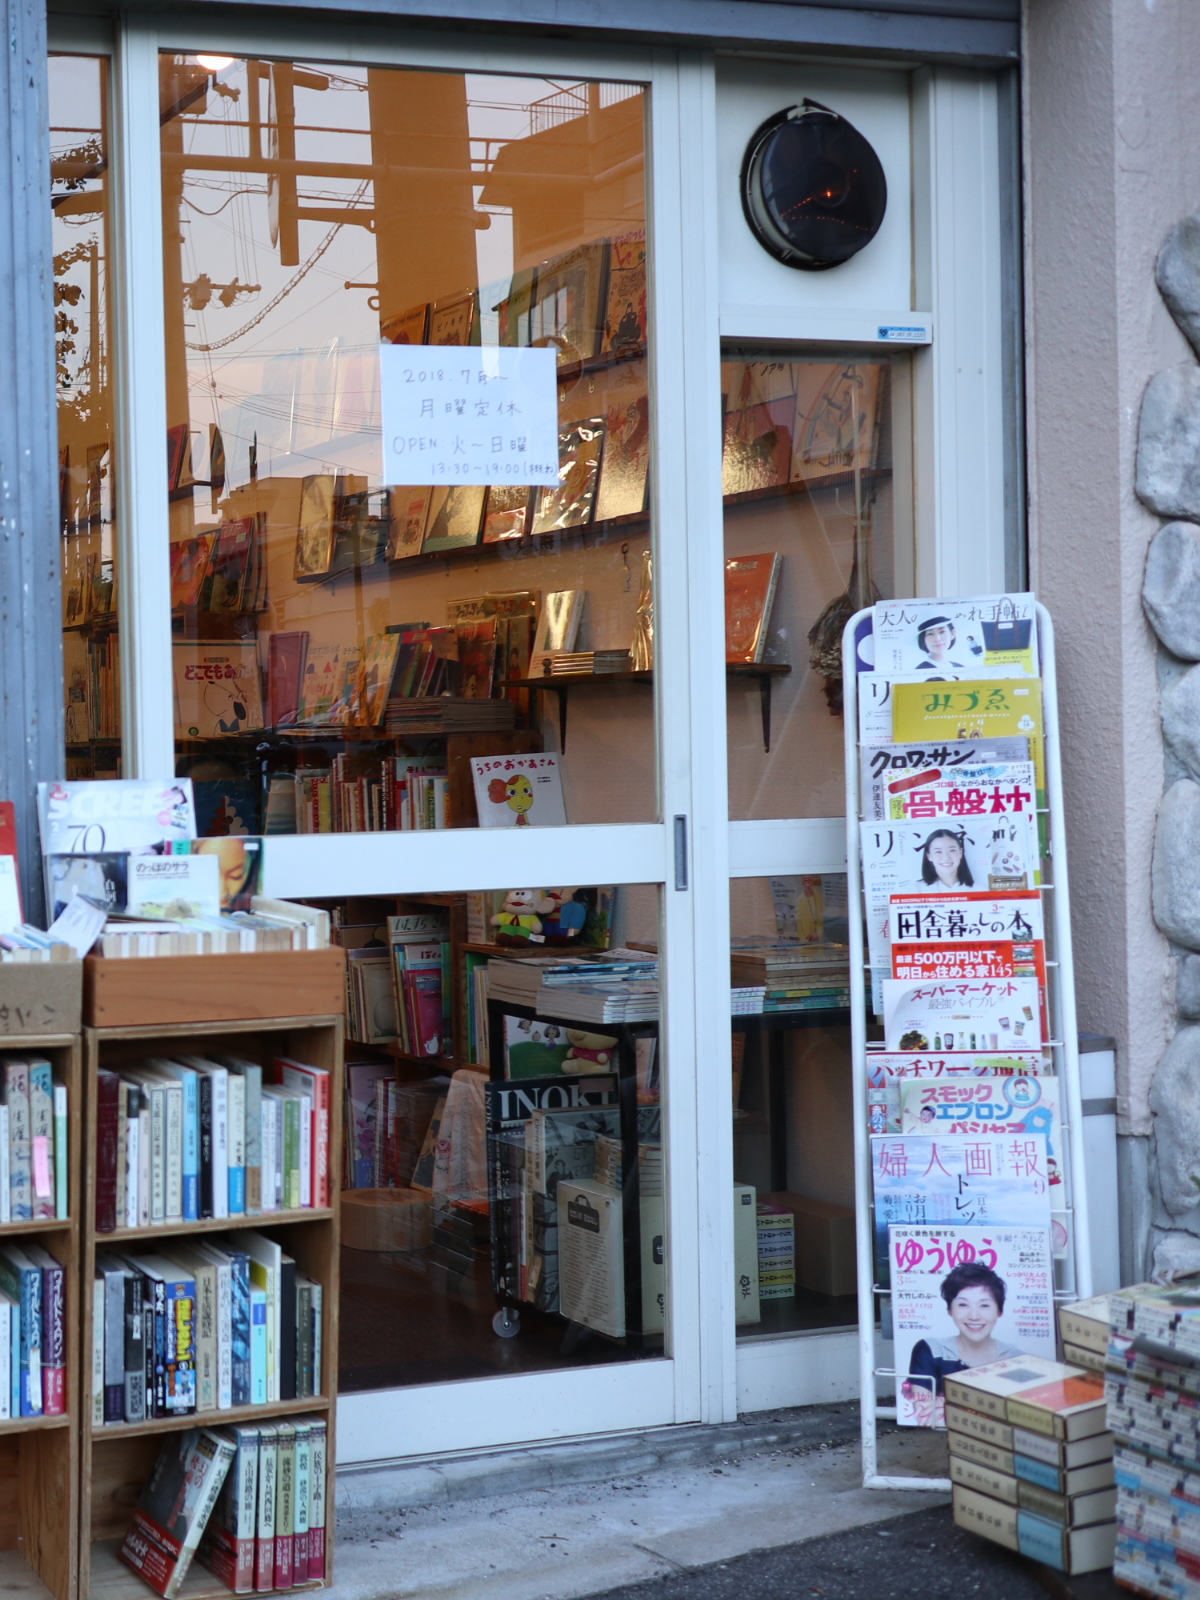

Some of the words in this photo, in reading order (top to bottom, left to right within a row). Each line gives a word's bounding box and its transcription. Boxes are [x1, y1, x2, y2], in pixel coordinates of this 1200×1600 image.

[420, 398, 522, 419] 月曜定休
[475, 758, 555, 776] うちのおかあさん
[870, 746, 976, 780] クロワッサン
[46, 789, 161, 819] SCREE
[897, 909, 1033, 940] 田舎暮らしの本
[896, 963, 1013, 980] 明日から住める家145
[910, 981, 1018, 1002] スーパーマーケット
[920, 1083, 993, 1104] スモック
[936, 1102, 1013, 1121] エプロン
[878, 1139, 1047, 1179] 婦人画報
[895, 1237, 999, 1273] ゆうゆう
